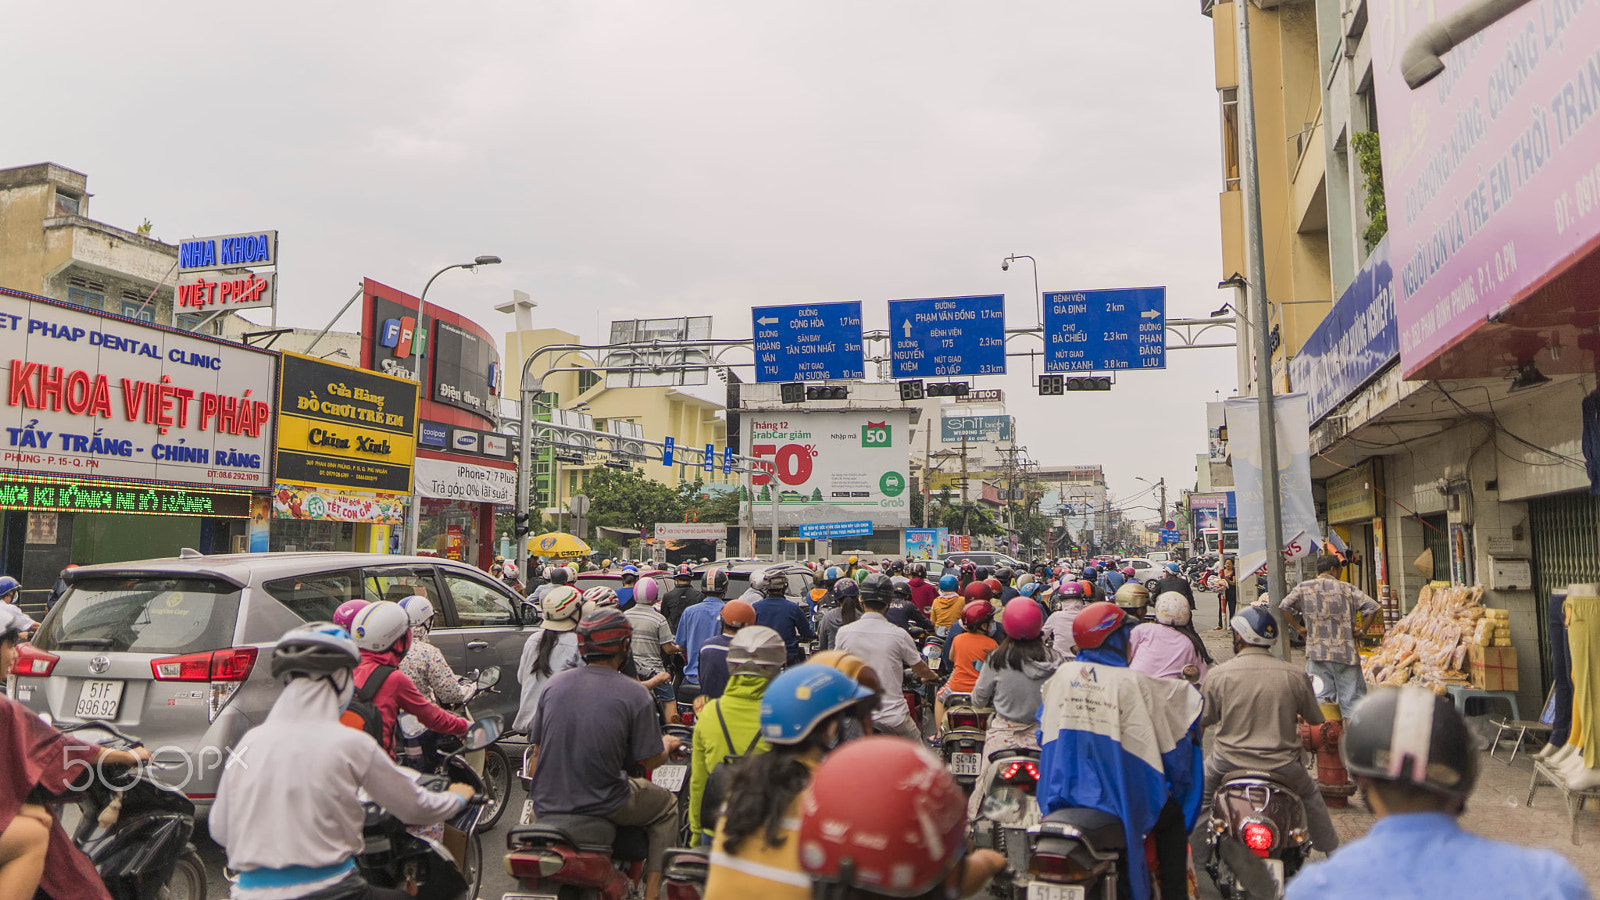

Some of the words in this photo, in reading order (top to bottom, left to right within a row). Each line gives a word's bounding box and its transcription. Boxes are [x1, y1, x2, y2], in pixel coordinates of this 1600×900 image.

[1489, 155, 1516, 223] EM
[1553, 188, 1574, 236] ĐT:
[180, 240, 216, 268] NHA
[220, 234, 269, 265] KHOA
[178, 277, 217, 310] VIỆT
[219, 272, 267, 304] PHÁP
[1053, 294, 1070, 303] BỆNH
[1071, 293, 1086, 302] VIỆN
[935, 301, 956, 310] ĐƯỜNG
[1053, 305, 1067, 314] GIA
[1068, 304, 1087, 315] ĐỊNH
[1106, 303, 1111, 312] 2
[1112, 303, 1125, 312] km
[798, 308, 818, 316] ĐƯỜNG
[915, 312, 937, 323] PHẠM
[938, 310, 951, 321] VĂN
[954, 308, 976, 320] ĐỒNG
[990, 310, 1003, 319] km
[789, 319, 808, 330] CỘNG
[810, 317, 825, 327] HÒA
[848, 317, 860, 326] km
[1062, 323, 1076, 332] CHỢ
[1139, 322, 1162, 332] ĐƯỜNG
[759, 330, 779, 338] ĐƯỜNG
[930, 328, 947, 337] BỆNH
[948, 327, 962, 336] VIỆN
[1052, 333, 1064, 344] BÀ
[1065, 330, 1088, 343] CHIỂU
[1116, 332, 1128, 341] km
[27, 317, 86, 344] PHAP
[89, 329, 164, 361] DENTAL
[168, 347, 223, 372] CLINIC
[797, 334, 810, 343] SÂN
[809, 334, 821, 342] BAY
[897, 340, 918, 349] ĐƯỜNG
[941, 339, 954, 348] 175
[990, 337, 1002, 346] km
[1139, 334, 1162, 343] PHAN
[756, 341, 780, 351] HOÀNG
[785, 346, 800, 355] TÂN
[801, 344, 817, 354] SƠN
[817, 341, 836, 353] NHẤT
[844, 344, 850, 352] 3
[849, 343, 861, 351] km
[1139, 346, 1162, 355] ĐĂNG
[761, 353, 776, 363] VĂN
[894, 347, 924, 360] NGUYỄN
[934, 355, 947, 364] NÚT
[947, 355, 962, 363] GIAO
[1055, 350, 1069, 359] NÚT
[1069, 350, 1084, 358] GIAO
[799, 362, 811, 370] NÚT
[811, 362, 824, 370] GIAO
[900, 361, 918, 373] KIỆM
[1047, 360, 1070, 371] HÀNG
[1071, 360, 1093, 370] XANH
[1116, 359, 1129, 369] km
[1142, 358, 1159, 367] LƯU
[764, 366, 779, 376] THỤ
[794, 372, 805, 380] AN
[806, 371, 830, 380] SƯƠNG
[842, 370, 849, 378] 10
[851, 370, 863, 378] km
[935, 365, 946, 375] GÒ
[947, 363, 961, 375] VẤP
[991, 364, 1003, 373] km
[8, 359, 113, 421] KHOA
[120, 375, 195, 436] VIỆT
[201, 389, 270, 439] PHÁP
[327, 383, 353, 398] Cửa
[354, 387, 385, 407] Hàng
[298, 391, 320, 412] ĐỒ
[321, 401, 357, 419] CHƠI
[358, 406, 386, 424] TRẺ
[386, 413, 405, 427] EM
[780, 421, 788, 429] 12
[423, 429, 446, 439] coolpad
[789, 431, 811, 444] giảm
[866, 430, 887, 443] 50
[6, 419, 54, 449] TẨY
[59, 428, 132, 457] TRẮNG
[151, 438, 211, 465] CHỈNH
[215, 447, 262, 470] RĂNG
[308, 428, 351, 453] Chim
[356, 436, 391, 456] Xinh
[85, 460, 99, 469] PN
[457, 466, 485, 480] iPhone
[486, 470, 491, 481] 7
[500, 473, 515, 484] Plus
[432, 480, 446, 494] Trả
[447, 482, 464, 497] góc
[466, 484, 480, 497] 0%
[481, 485, 491, 497] lãi
[492, 486, 508, 500] suất
[327, 498, 341, 513] TẾT
[343, 508, 358, 519] CON
[880, 498, 904, 508] Grab
[912, 533, 931, 542] 2017
[89, 682, 114, 699] 51F
[77, 699, 117, 717] 996.92
